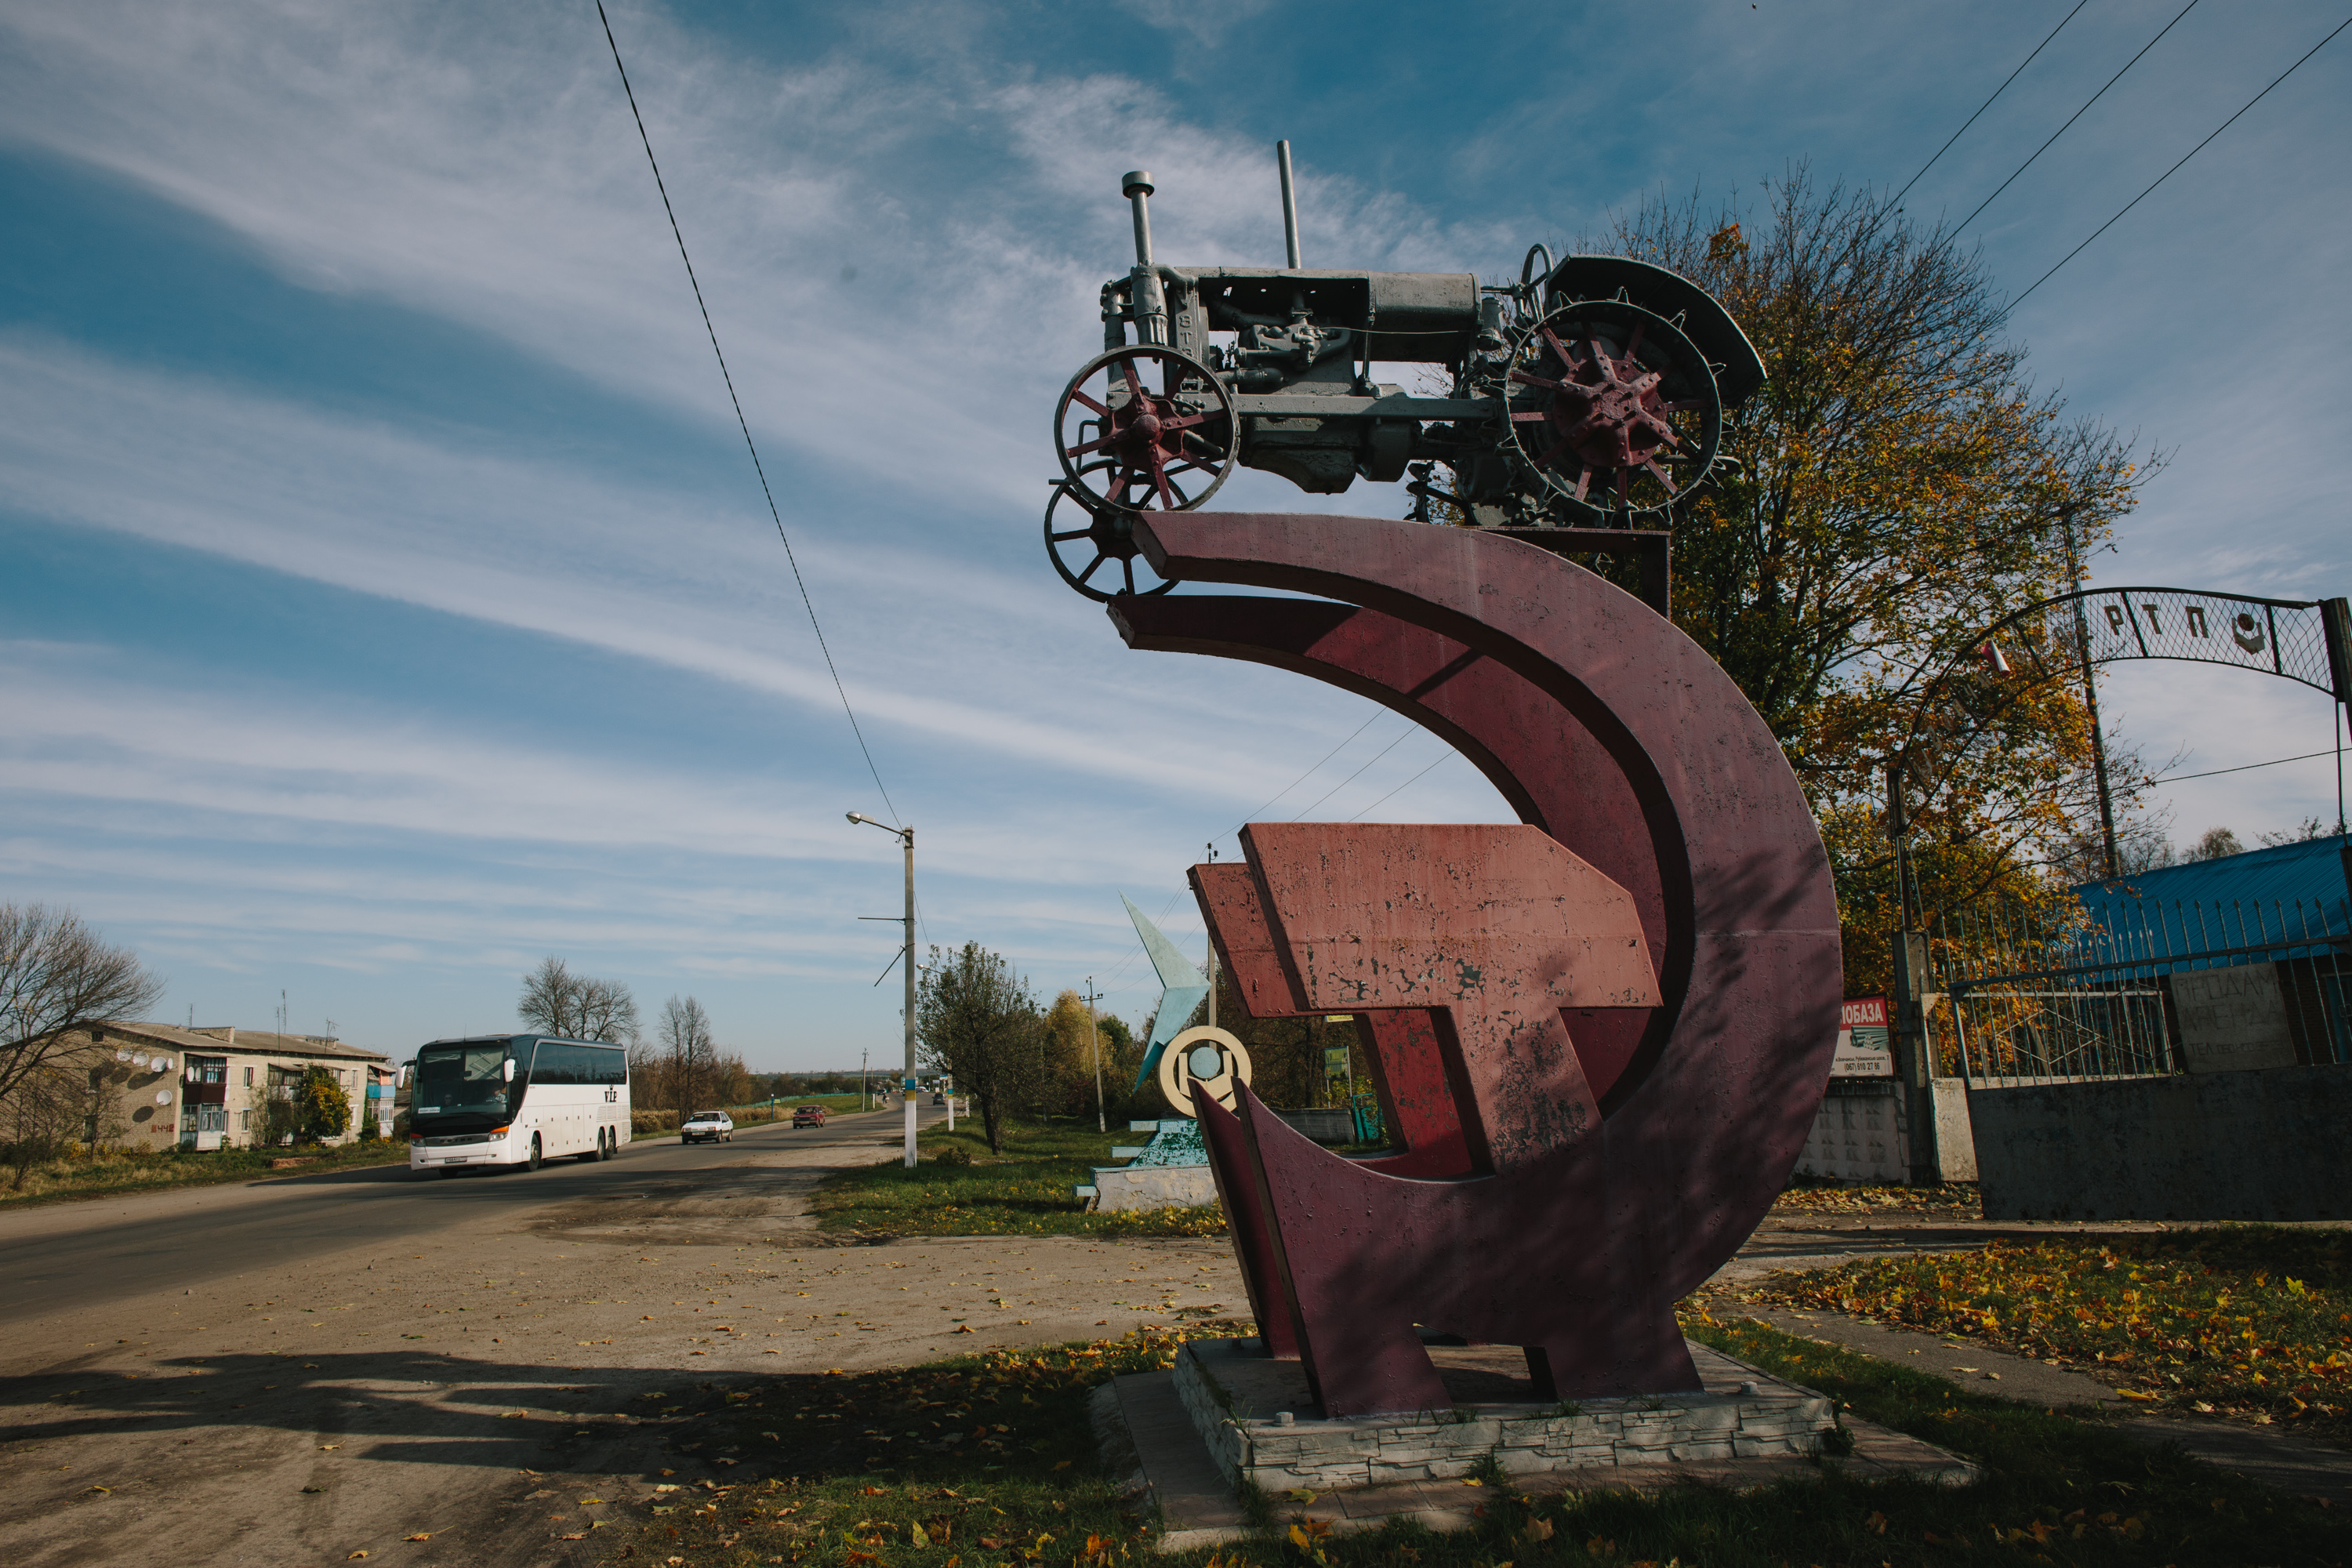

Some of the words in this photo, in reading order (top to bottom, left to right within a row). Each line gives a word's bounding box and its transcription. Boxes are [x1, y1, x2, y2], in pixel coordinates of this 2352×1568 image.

[2175, 969, 2278, 1002] ПРОДАМ
[2183, 1000, 2282, 1032] АРЕНДА
[2188, 1042, 2215, 1056] ТЕЛ
[1844, 1063, 1857, 1073] (067)
